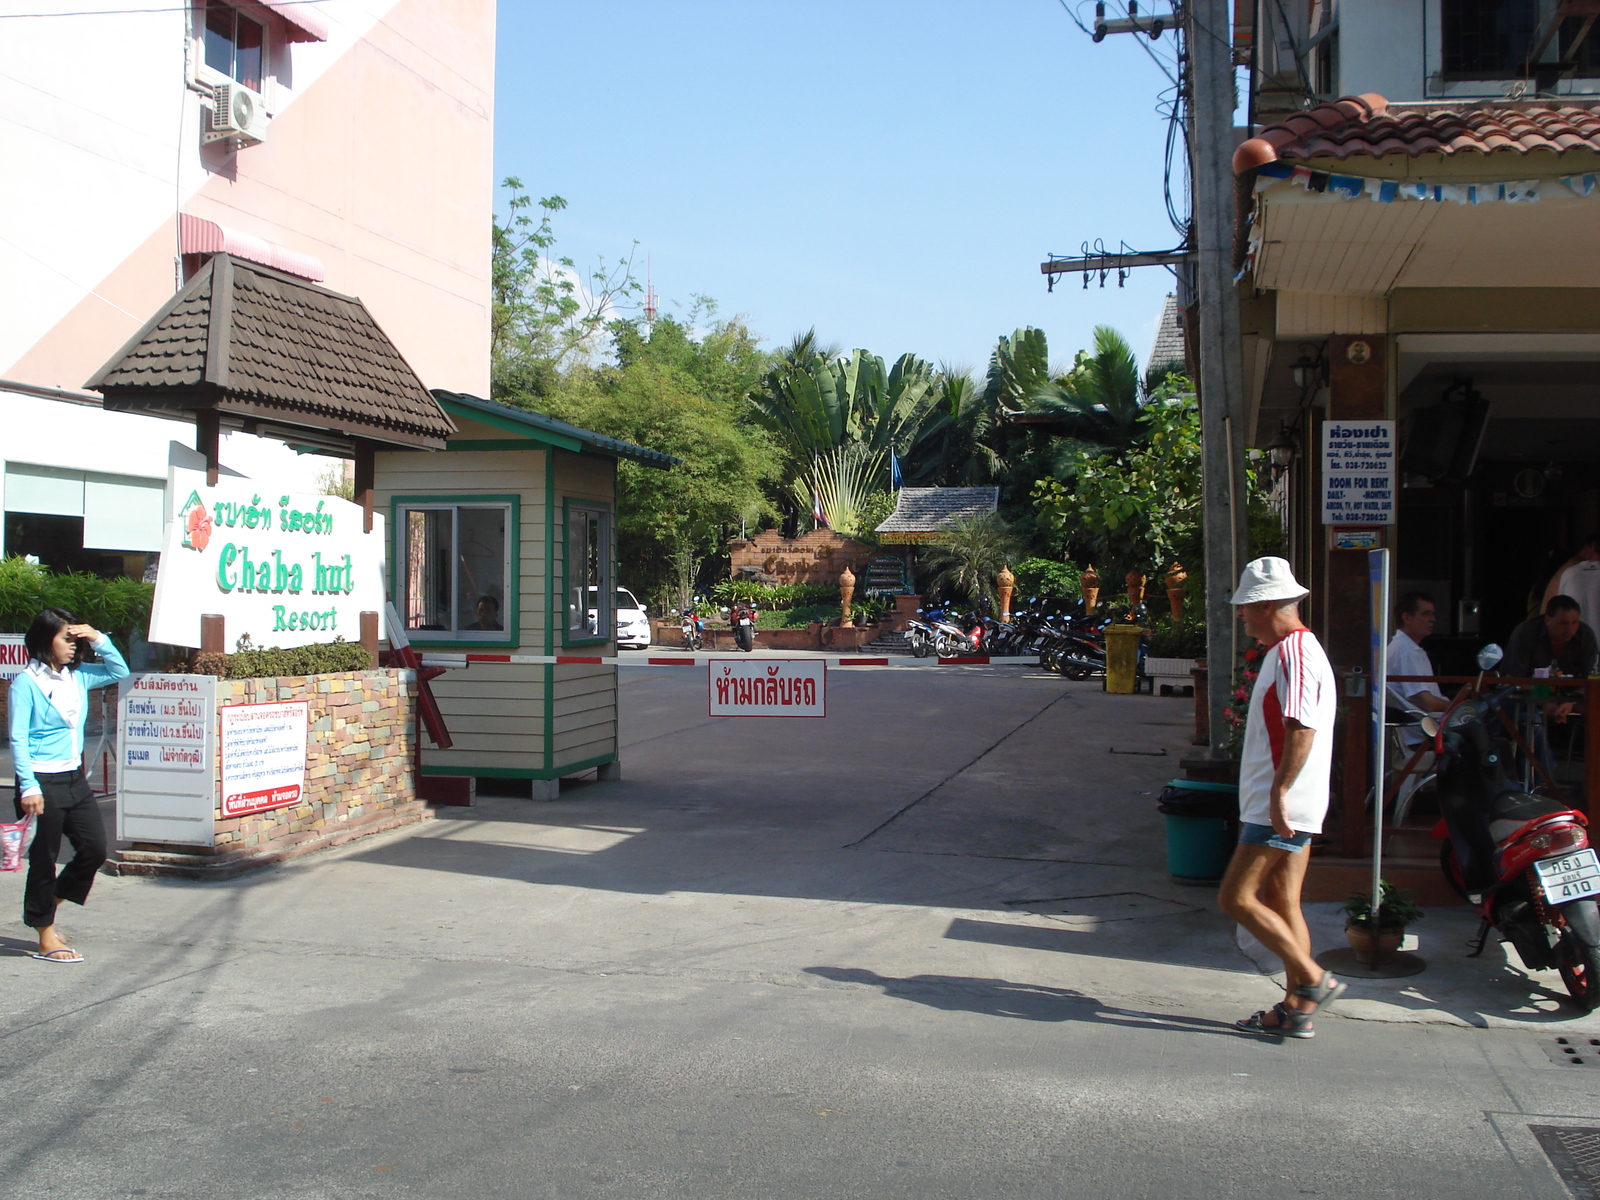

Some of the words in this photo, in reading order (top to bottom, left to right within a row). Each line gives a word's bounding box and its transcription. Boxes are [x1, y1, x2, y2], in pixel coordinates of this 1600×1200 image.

[1345, 461, 1387, 470] 038-720623
[1329, 477, 1352, 488] ROOM
[1354, 477, 1369, 488] FOR
[1370, 477, 1389, 488] RENT
[1353, 501, 1363, 510] HOT
[1345, 512, 1388, 521] 038-720623
[217, 542, 304, 594] Chaba
[312, 552, 355, 595] hut
[272, 605, 338, 632] Resort
[133, 677, 198, 692] รับสมัครงาน
[716, 666, 816, 705] ห้ามกลับรถ
[1562, 881, 1592, 896] 410
